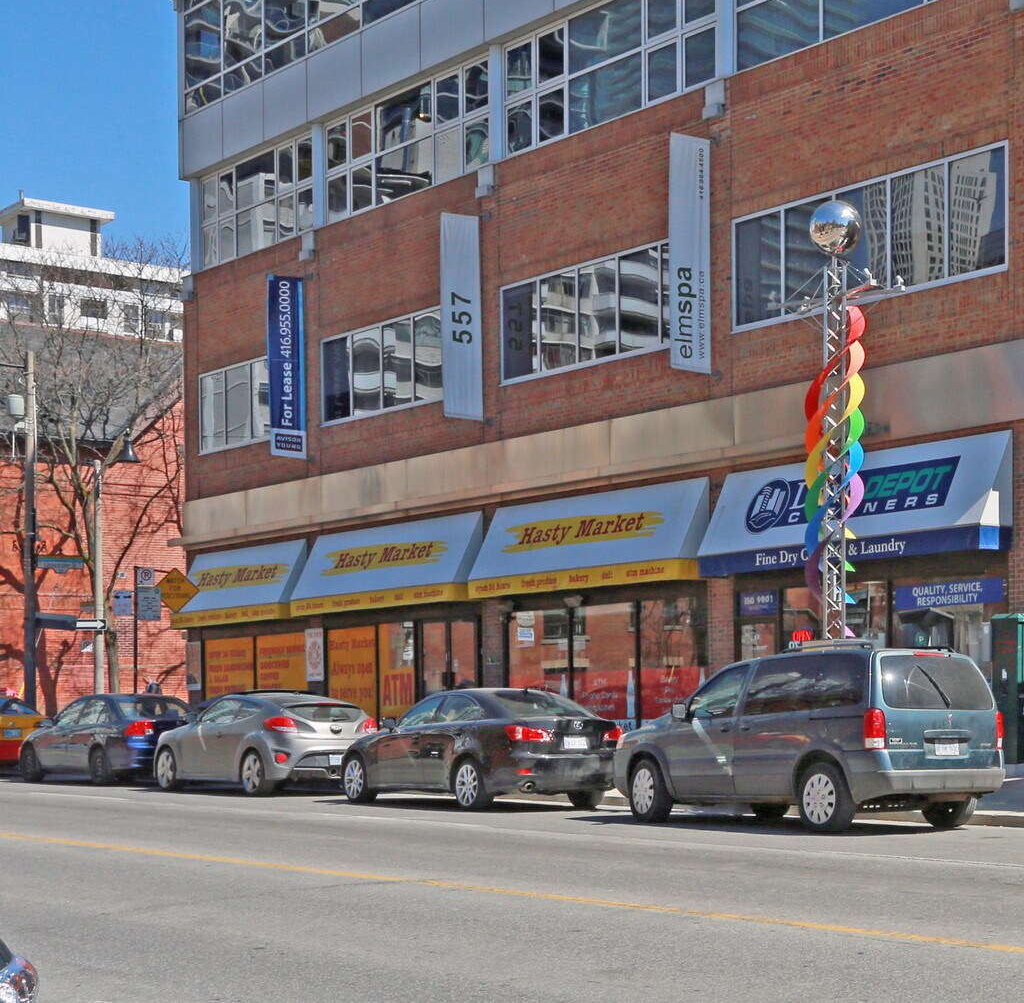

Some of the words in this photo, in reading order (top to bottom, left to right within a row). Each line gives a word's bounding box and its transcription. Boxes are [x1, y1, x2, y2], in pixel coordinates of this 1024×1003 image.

[279, 280, 292, 358] 416.955.0000
[451, 292, 472, 344] 557
[674, 267, 697, 359] elmspa
[282, 363, 293, 396] Lease
[282, 405, 293, 427] For
[276, 435, 301, 443] AVISON
[276, 442, 301, 450] YOUNG
[863, 465, 953, 500] DEPOT
[518, 525, 572, 545] Hasty
[574, 512, 645, 538] Market
[334, 553, 378, 569] Hasty
[378, 541, 434, 564] Market
[755, 552, 777, 566] Fine
[779, 550, 798, 565] Dry
[849, 543, 858, 555] &
[860, 538, 906, 555] Laundry
[197, 572, 232, 588] Hasty
[233, 565, 278, 583] Market
[744, 596, 755, 605] ISO
[756, 594, 774, 604] 9001
[912, 585, 947, 597] QUALITY,
[949, 582, 983, 594] SERVICE,
[917, 594, 978, 606] RESPONSIBILITY
[792, 630, 812, 642] OPEN
[332, 661, 354, 678] Always
[383, 673, 413, 706] ATM
[593, 678, 607, 687] ATM
